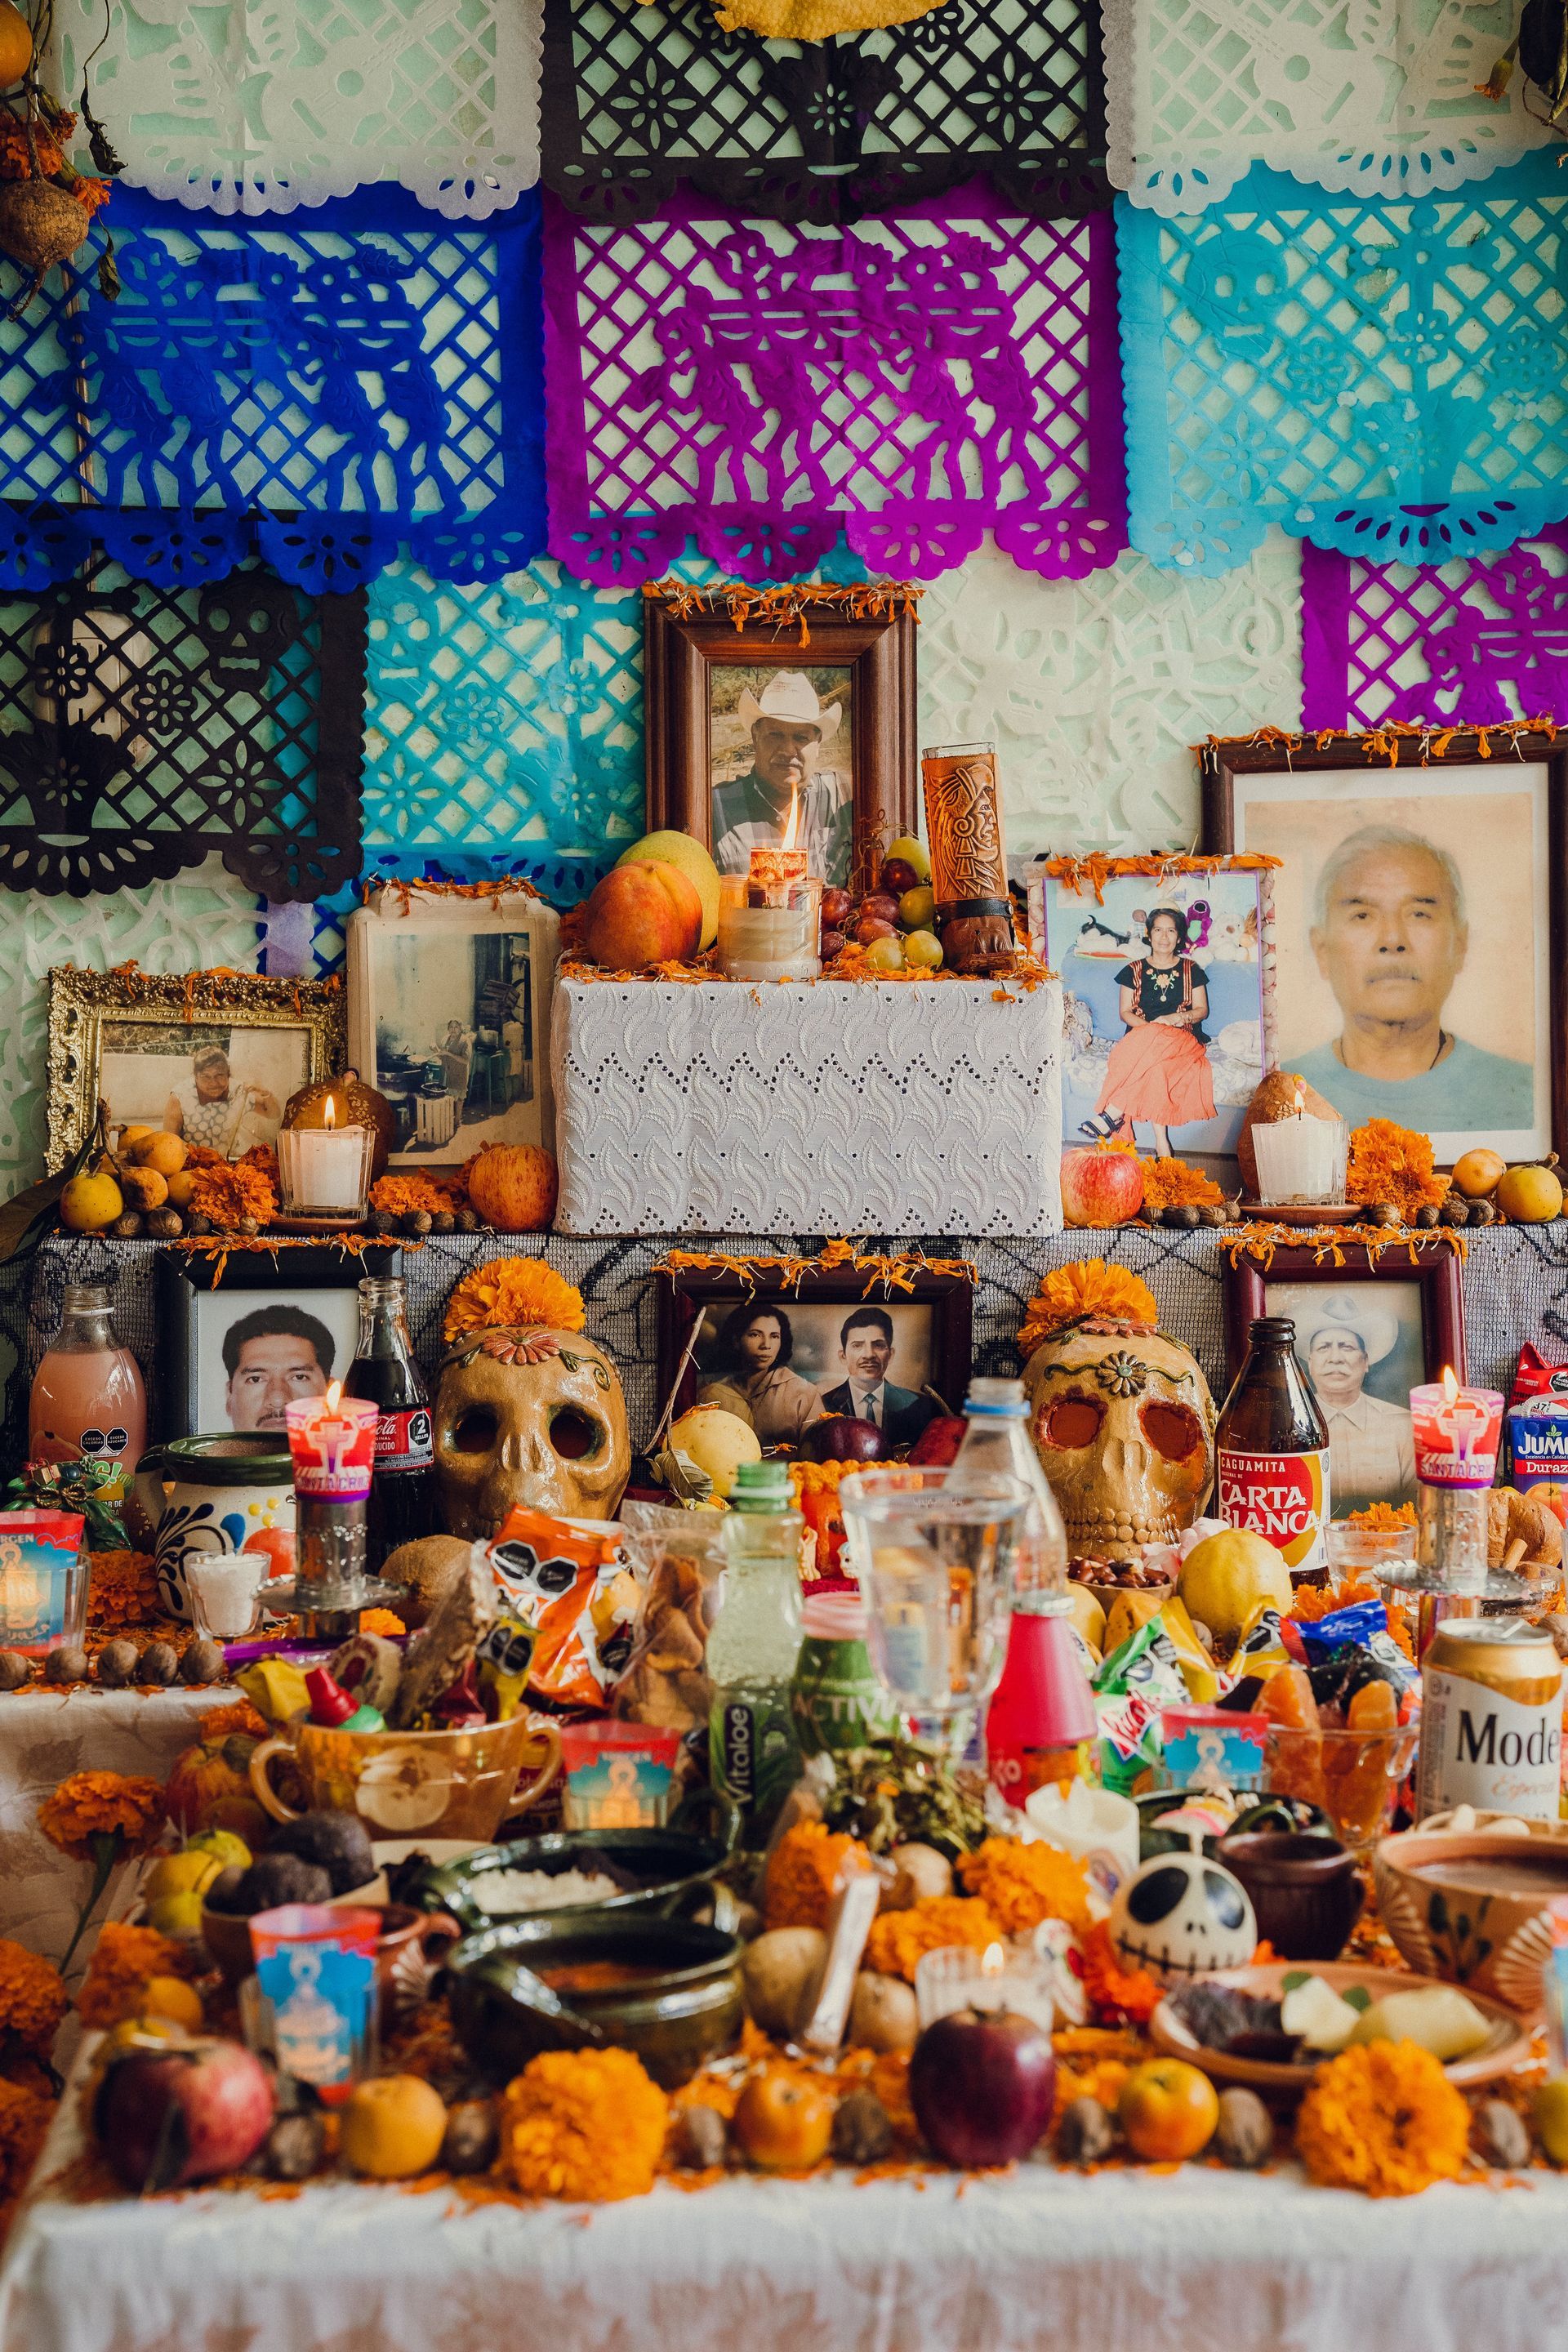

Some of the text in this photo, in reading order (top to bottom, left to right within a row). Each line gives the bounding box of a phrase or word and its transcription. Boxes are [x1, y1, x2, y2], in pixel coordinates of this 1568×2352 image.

[417, 1419, 426, 1435] 2
[1221, 1456, 1286, 1472] CAGUAMITA
[114, 1499, 123, 1508] DE
[1220, 1479, 1307, 1512] CARTA
[724, 1707, 753, 1805] Vitaloe
